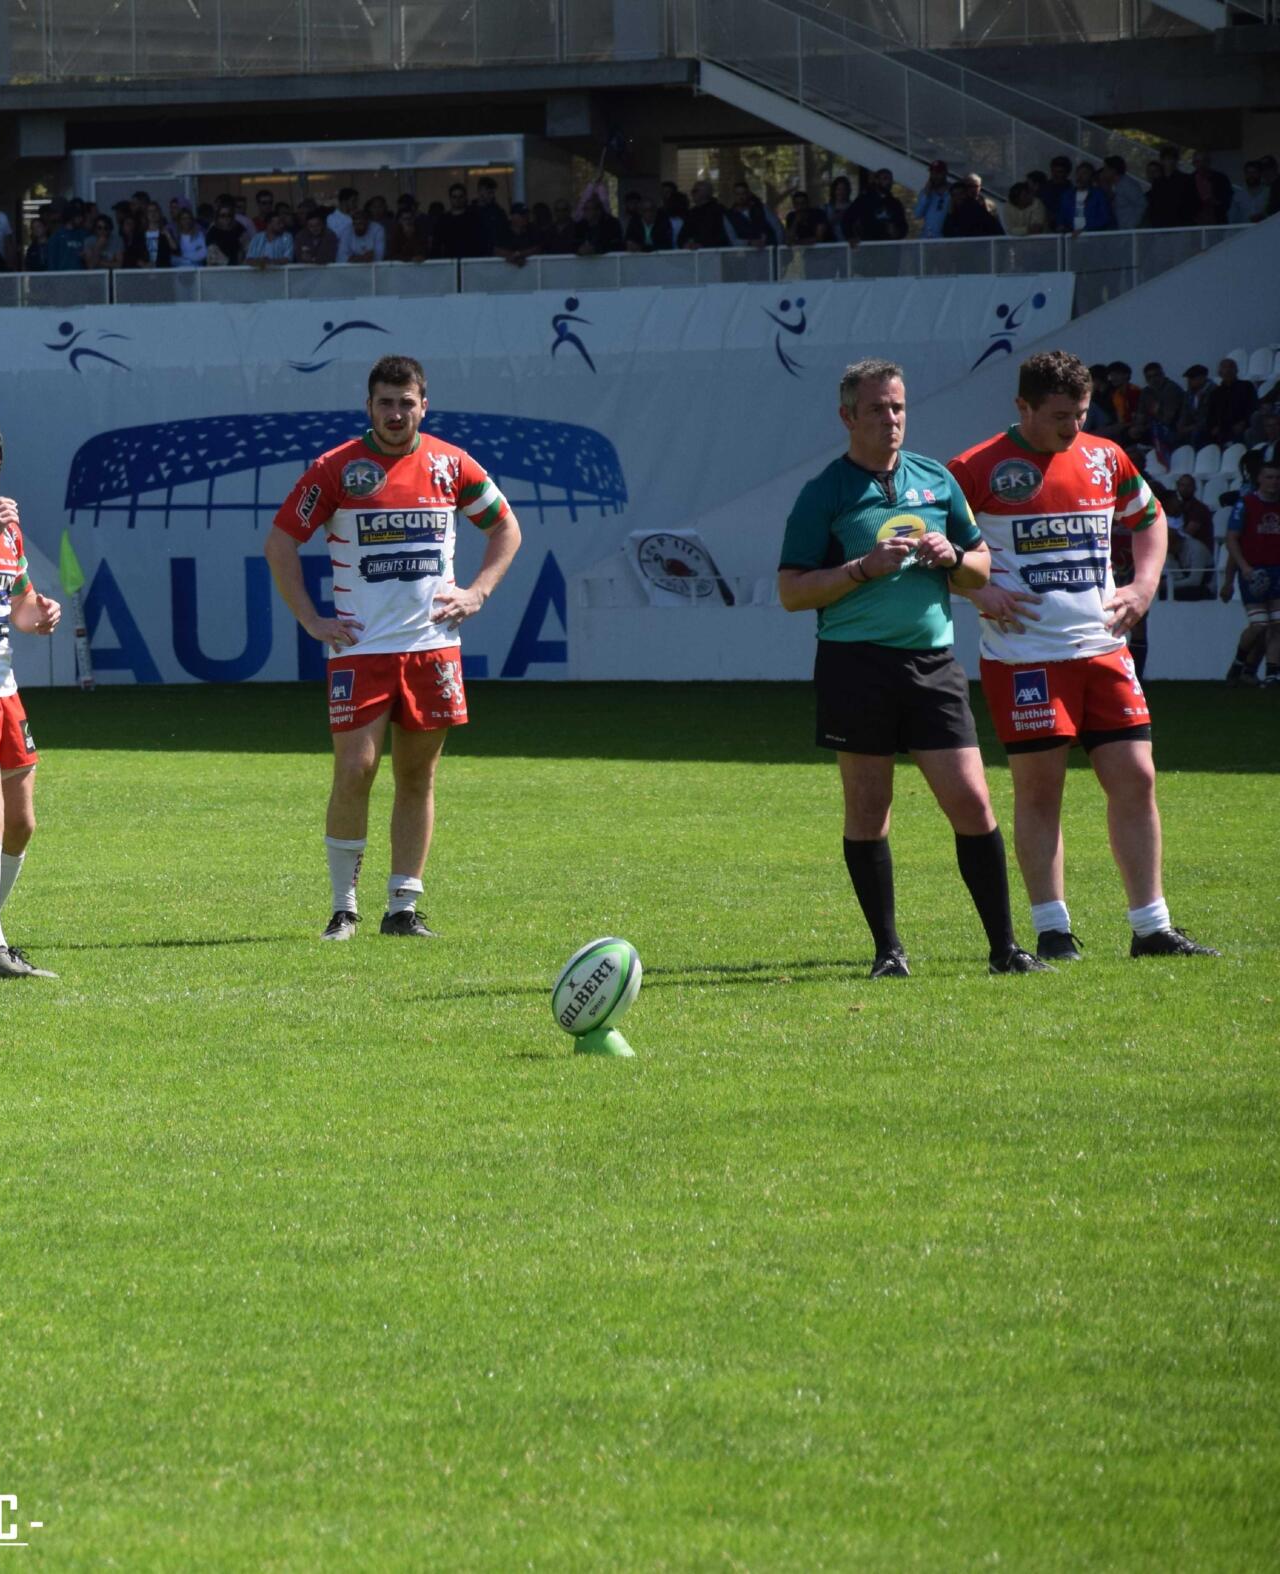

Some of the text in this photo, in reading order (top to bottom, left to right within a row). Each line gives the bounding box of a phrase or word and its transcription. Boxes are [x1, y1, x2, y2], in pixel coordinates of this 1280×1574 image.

[996, 471, 1035, 491] EKI
[358, 512, 447, 531] LAGUNE
[1016, 517, 1108, 539] LAGUNE
[367, 559, 439, 573] CIMENTS LA UNION
[1028, 569, 1069, 583] CIMENTS
[1016, 687, 1042, 701] AXA
[1011, 708, 1056, 721] Matthieu
[1014, 718, 1056, 732] Bisquey
[559, 957, 616, 1028] GILBERT
